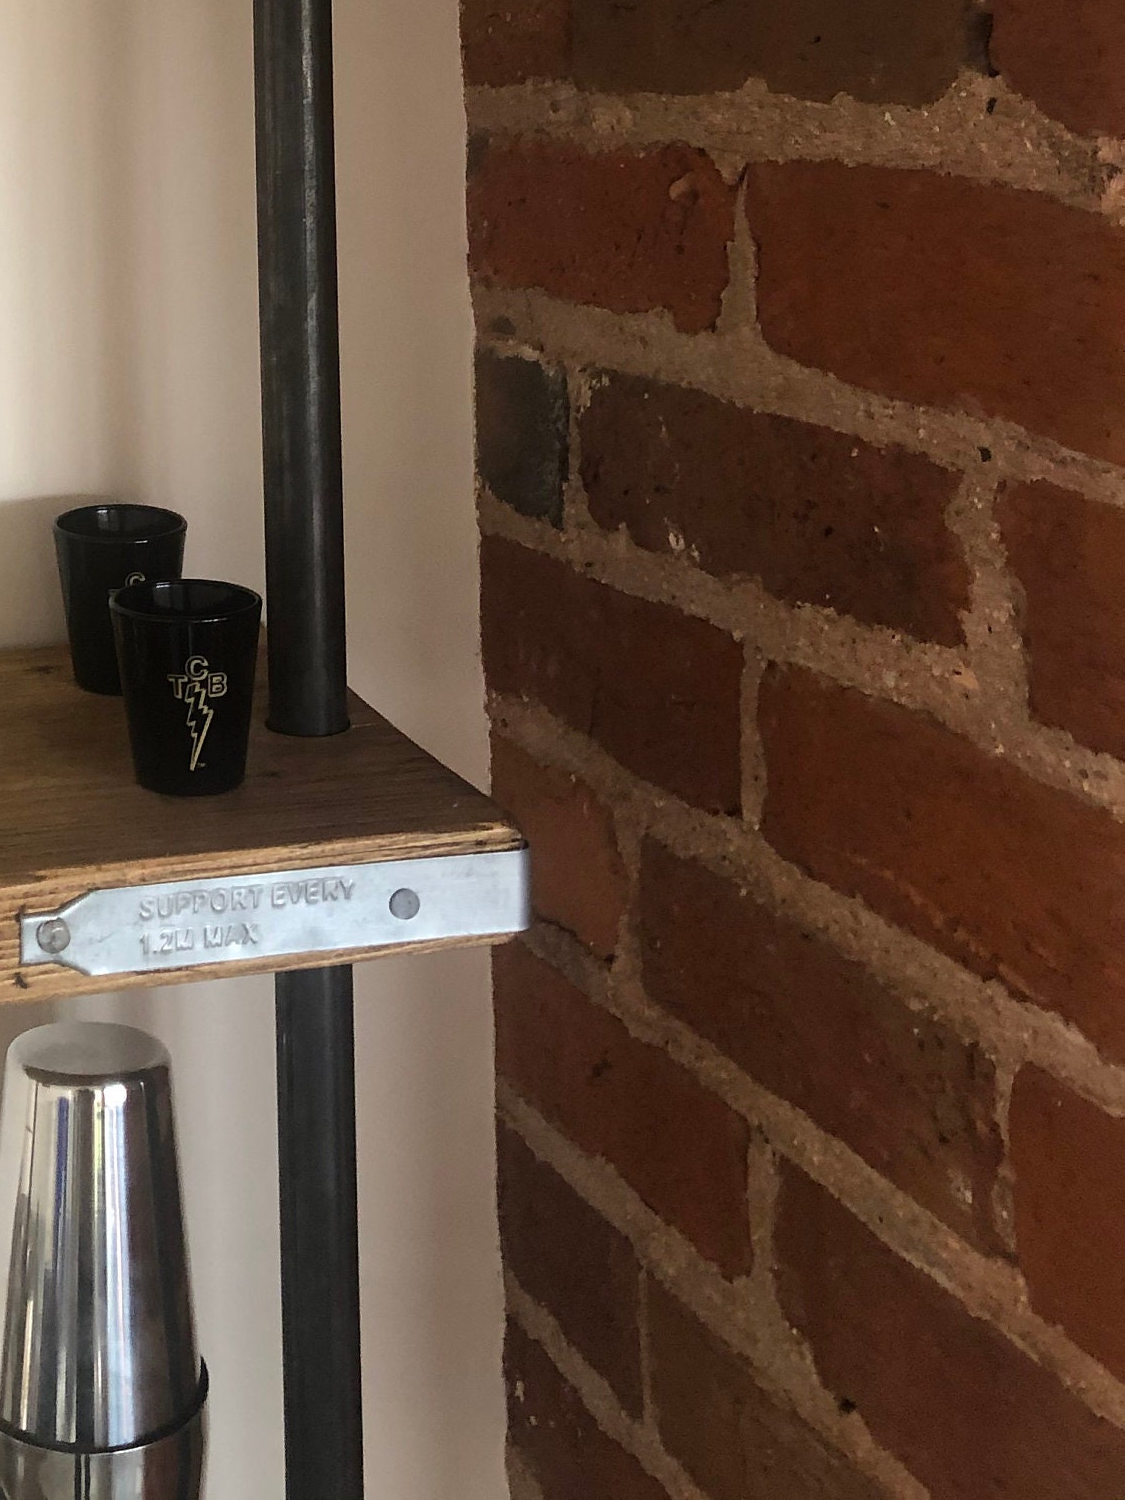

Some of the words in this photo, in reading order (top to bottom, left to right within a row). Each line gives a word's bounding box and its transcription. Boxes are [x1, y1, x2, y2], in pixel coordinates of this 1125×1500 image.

[138, 885, 263, 921] SUPPORT
[271, 877, 357, 909] EVERY
[138, 926, 194, 955] 1.2M
[203, 922, 259, 949] MAX
